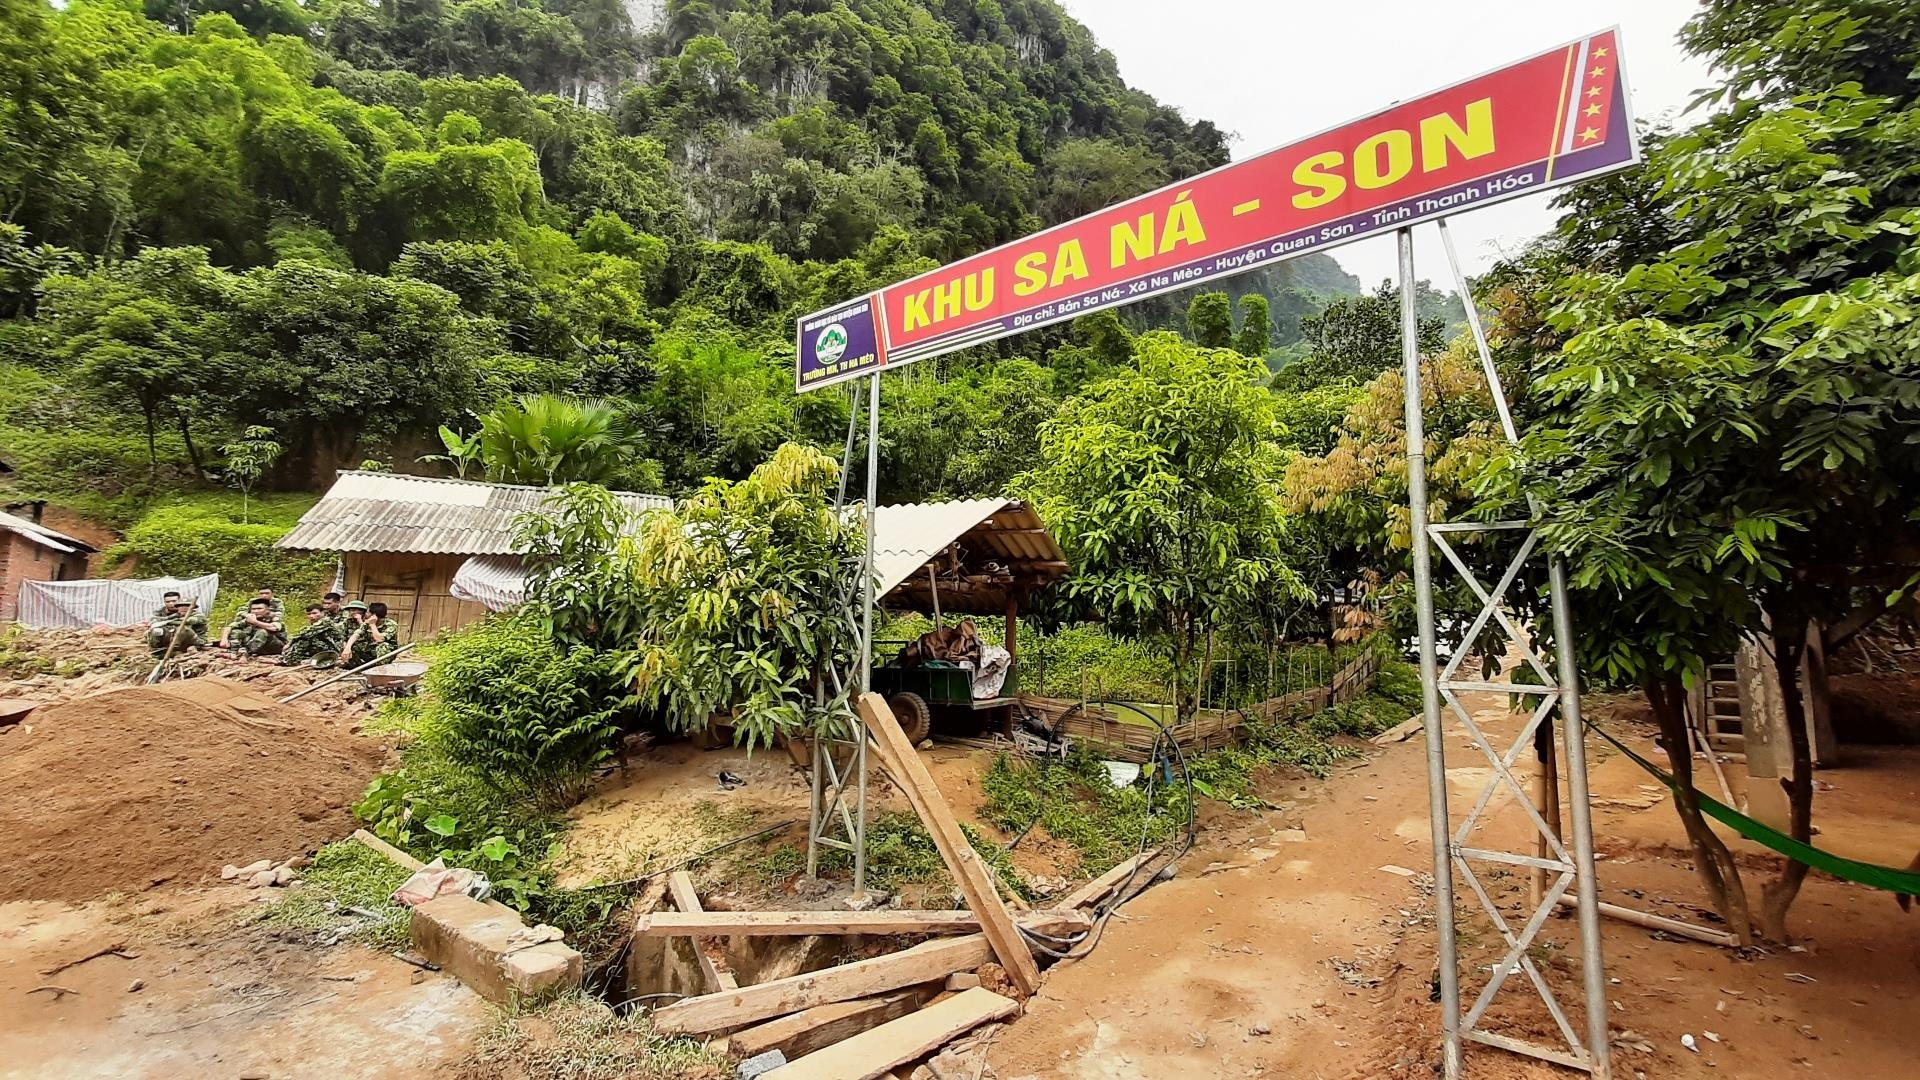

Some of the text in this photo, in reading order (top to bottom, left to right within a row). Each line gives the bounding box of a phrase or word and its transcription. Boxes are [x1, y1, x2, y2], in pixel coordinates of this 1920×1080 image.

[903, 267, 995, 333] KHU
[1013, 237, 1089, 297] SA
[1110, 189, 1207, 269] NÁ
[1291, 96, 1496, 210] SON
[1014, 312, 1032, 327] Địa
[1035, 305, 1055, 319] chỉ:
[1058, 298, 1081, 314] Bản
[1083, 296, 1099, 307] Sa
[1129, 280, 1147, 294] Xã
[1151, 275, 1169, 289] Na
[1172, 267, 1203, 281] Mèo
[1216, 247, 1266, 270] Huyện
[1271, 233, 1315, 255] Quan
[1321, 223, 1354, 240] Sơn
[1372, 204, 1411, 226] Tỉnh
[1416, 186, 1480, 214] Thanh
[1486, 172, 1534, 194] Hóa
